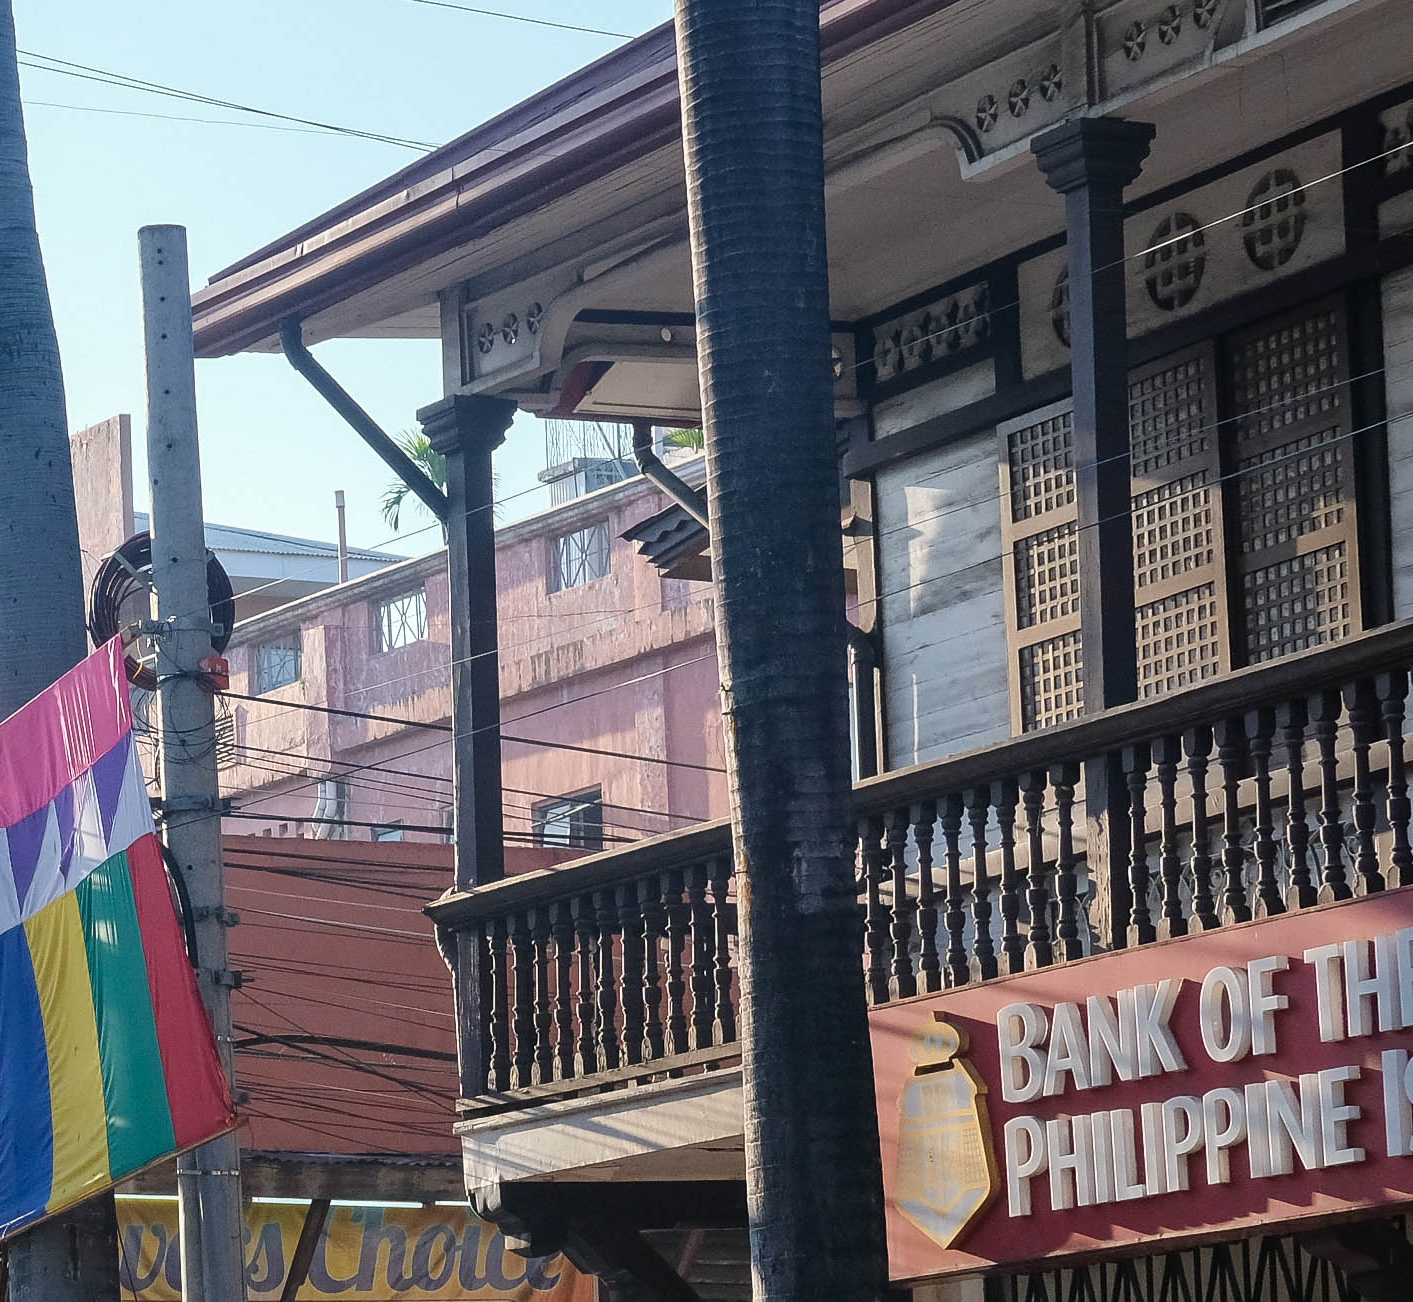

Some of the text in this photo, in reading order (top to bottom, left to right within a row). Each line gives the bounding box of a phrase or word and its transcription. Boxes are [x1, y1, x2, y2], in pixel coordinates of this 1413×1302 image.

[996, 977, 1188, 1103] BANK
[1199, 955, 1289, 1063] OF
[1004, 1065, 1366, 1217] PHILIPPINE
